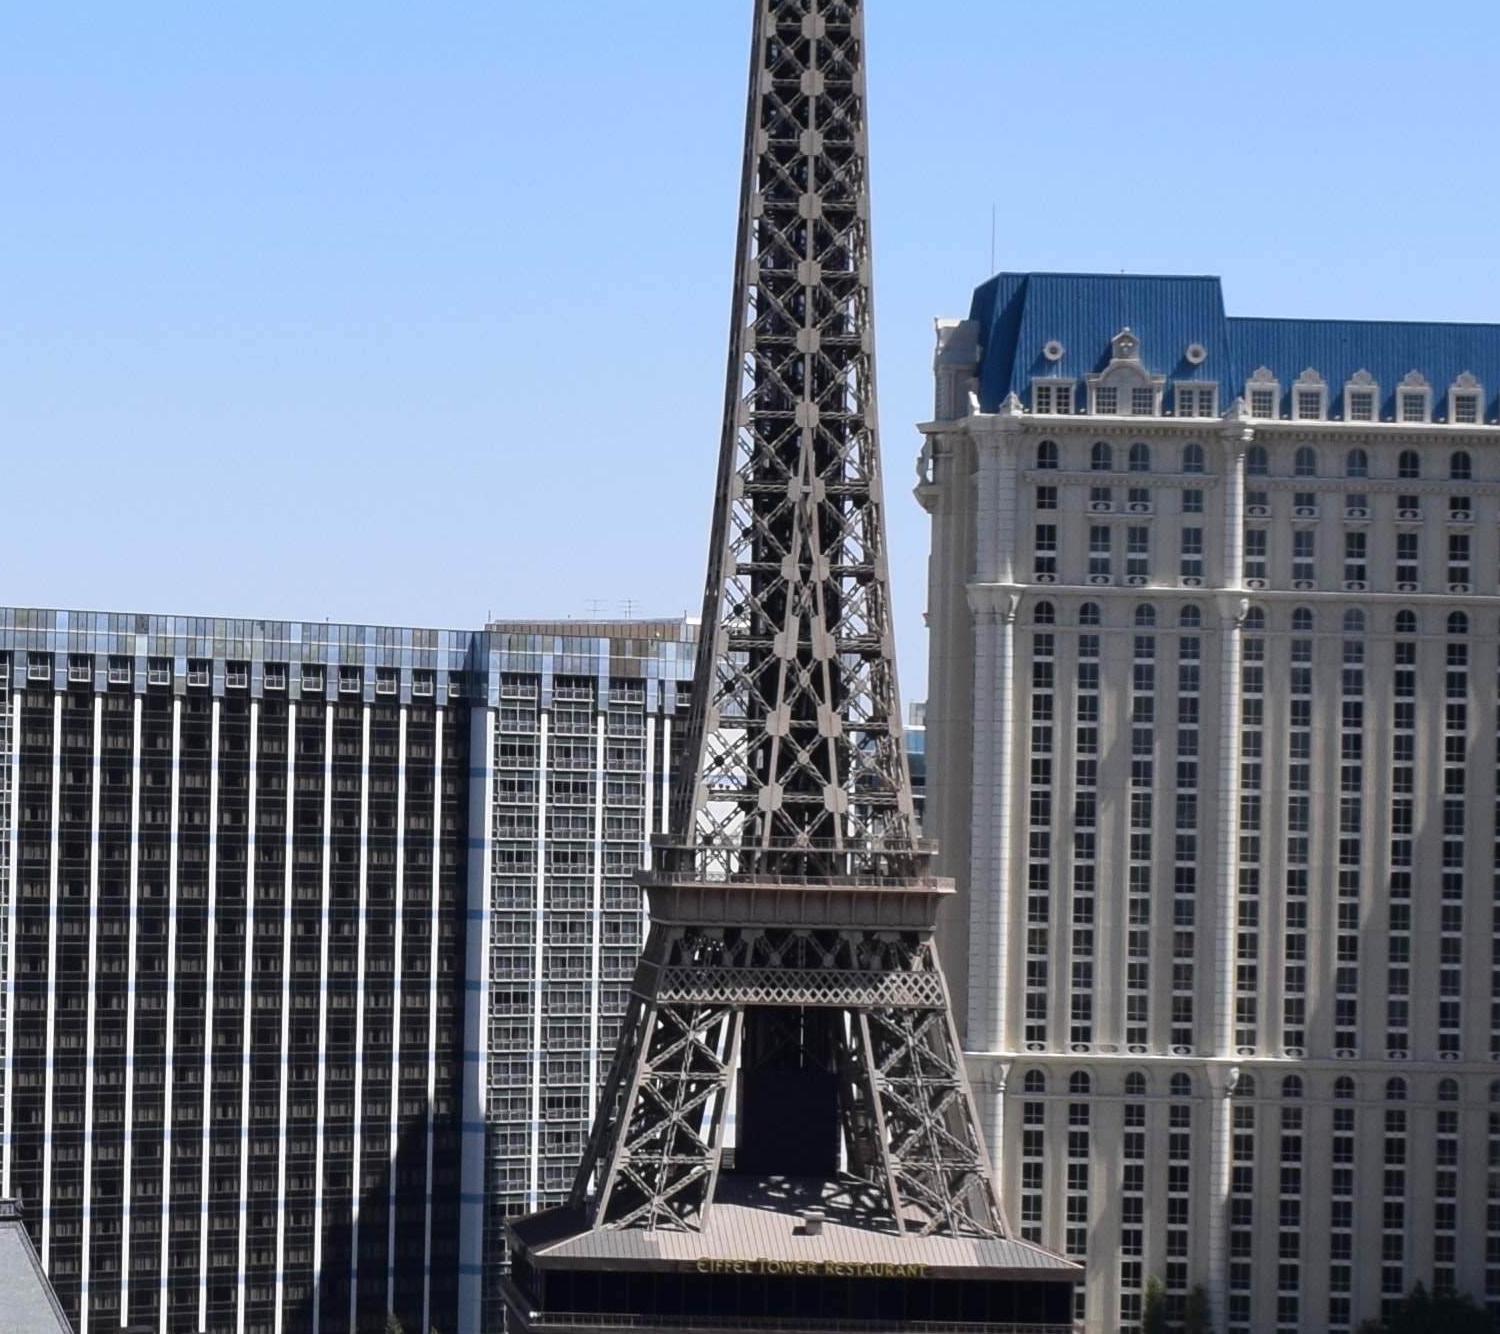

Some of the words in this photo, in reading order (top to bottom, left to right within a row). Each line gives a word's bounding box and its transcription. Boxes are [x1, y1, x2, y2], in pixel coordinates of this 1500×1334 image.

[697, 1257, 753, 1274] EIFFEL
[756, 1257, 817, 1276] TOWER
[823, 1260, 929, 1278] RESTAURANT
